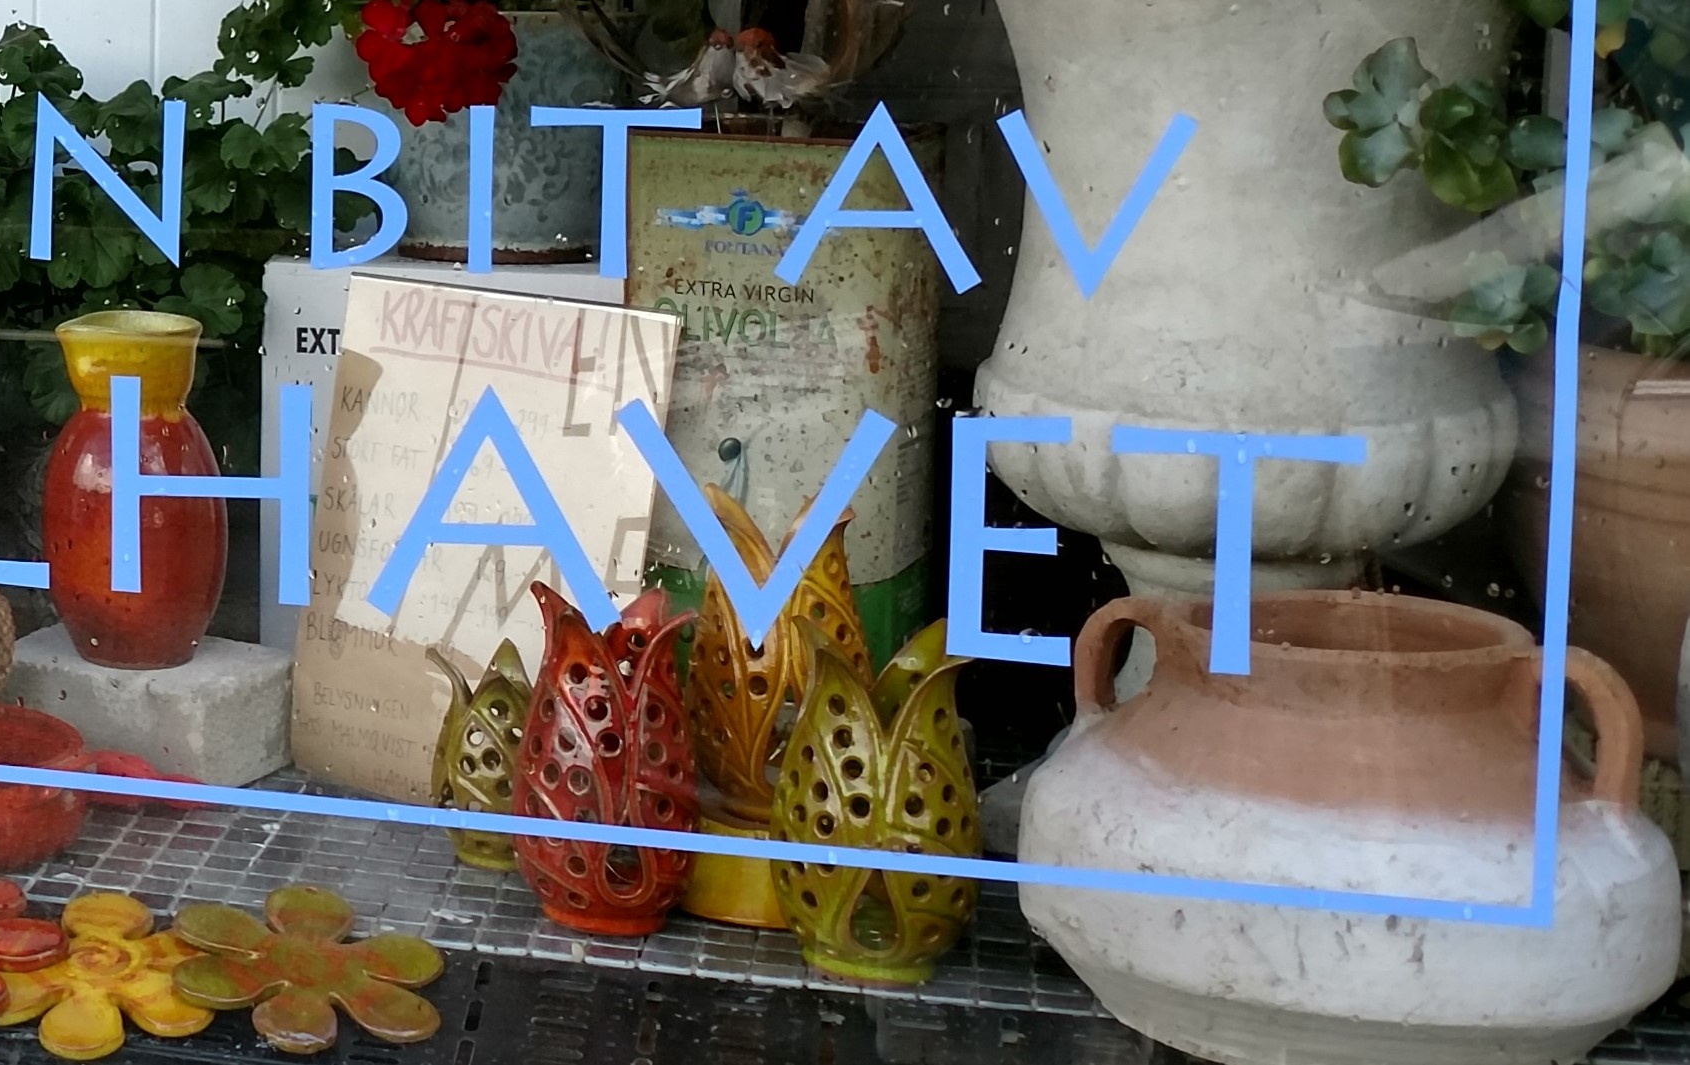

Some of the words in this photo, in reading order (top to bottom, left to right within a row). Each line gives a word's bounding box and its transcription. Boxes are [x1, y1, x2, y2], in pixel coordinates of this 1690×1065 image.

[310, 103, 702, 278] BIT
[776, 103, 1196, 297] AV
[674, 278, 736, 299] EXTRA
[742, 284, 815, 305] VIRGIN
[296, 327, 341, 355] EXT
